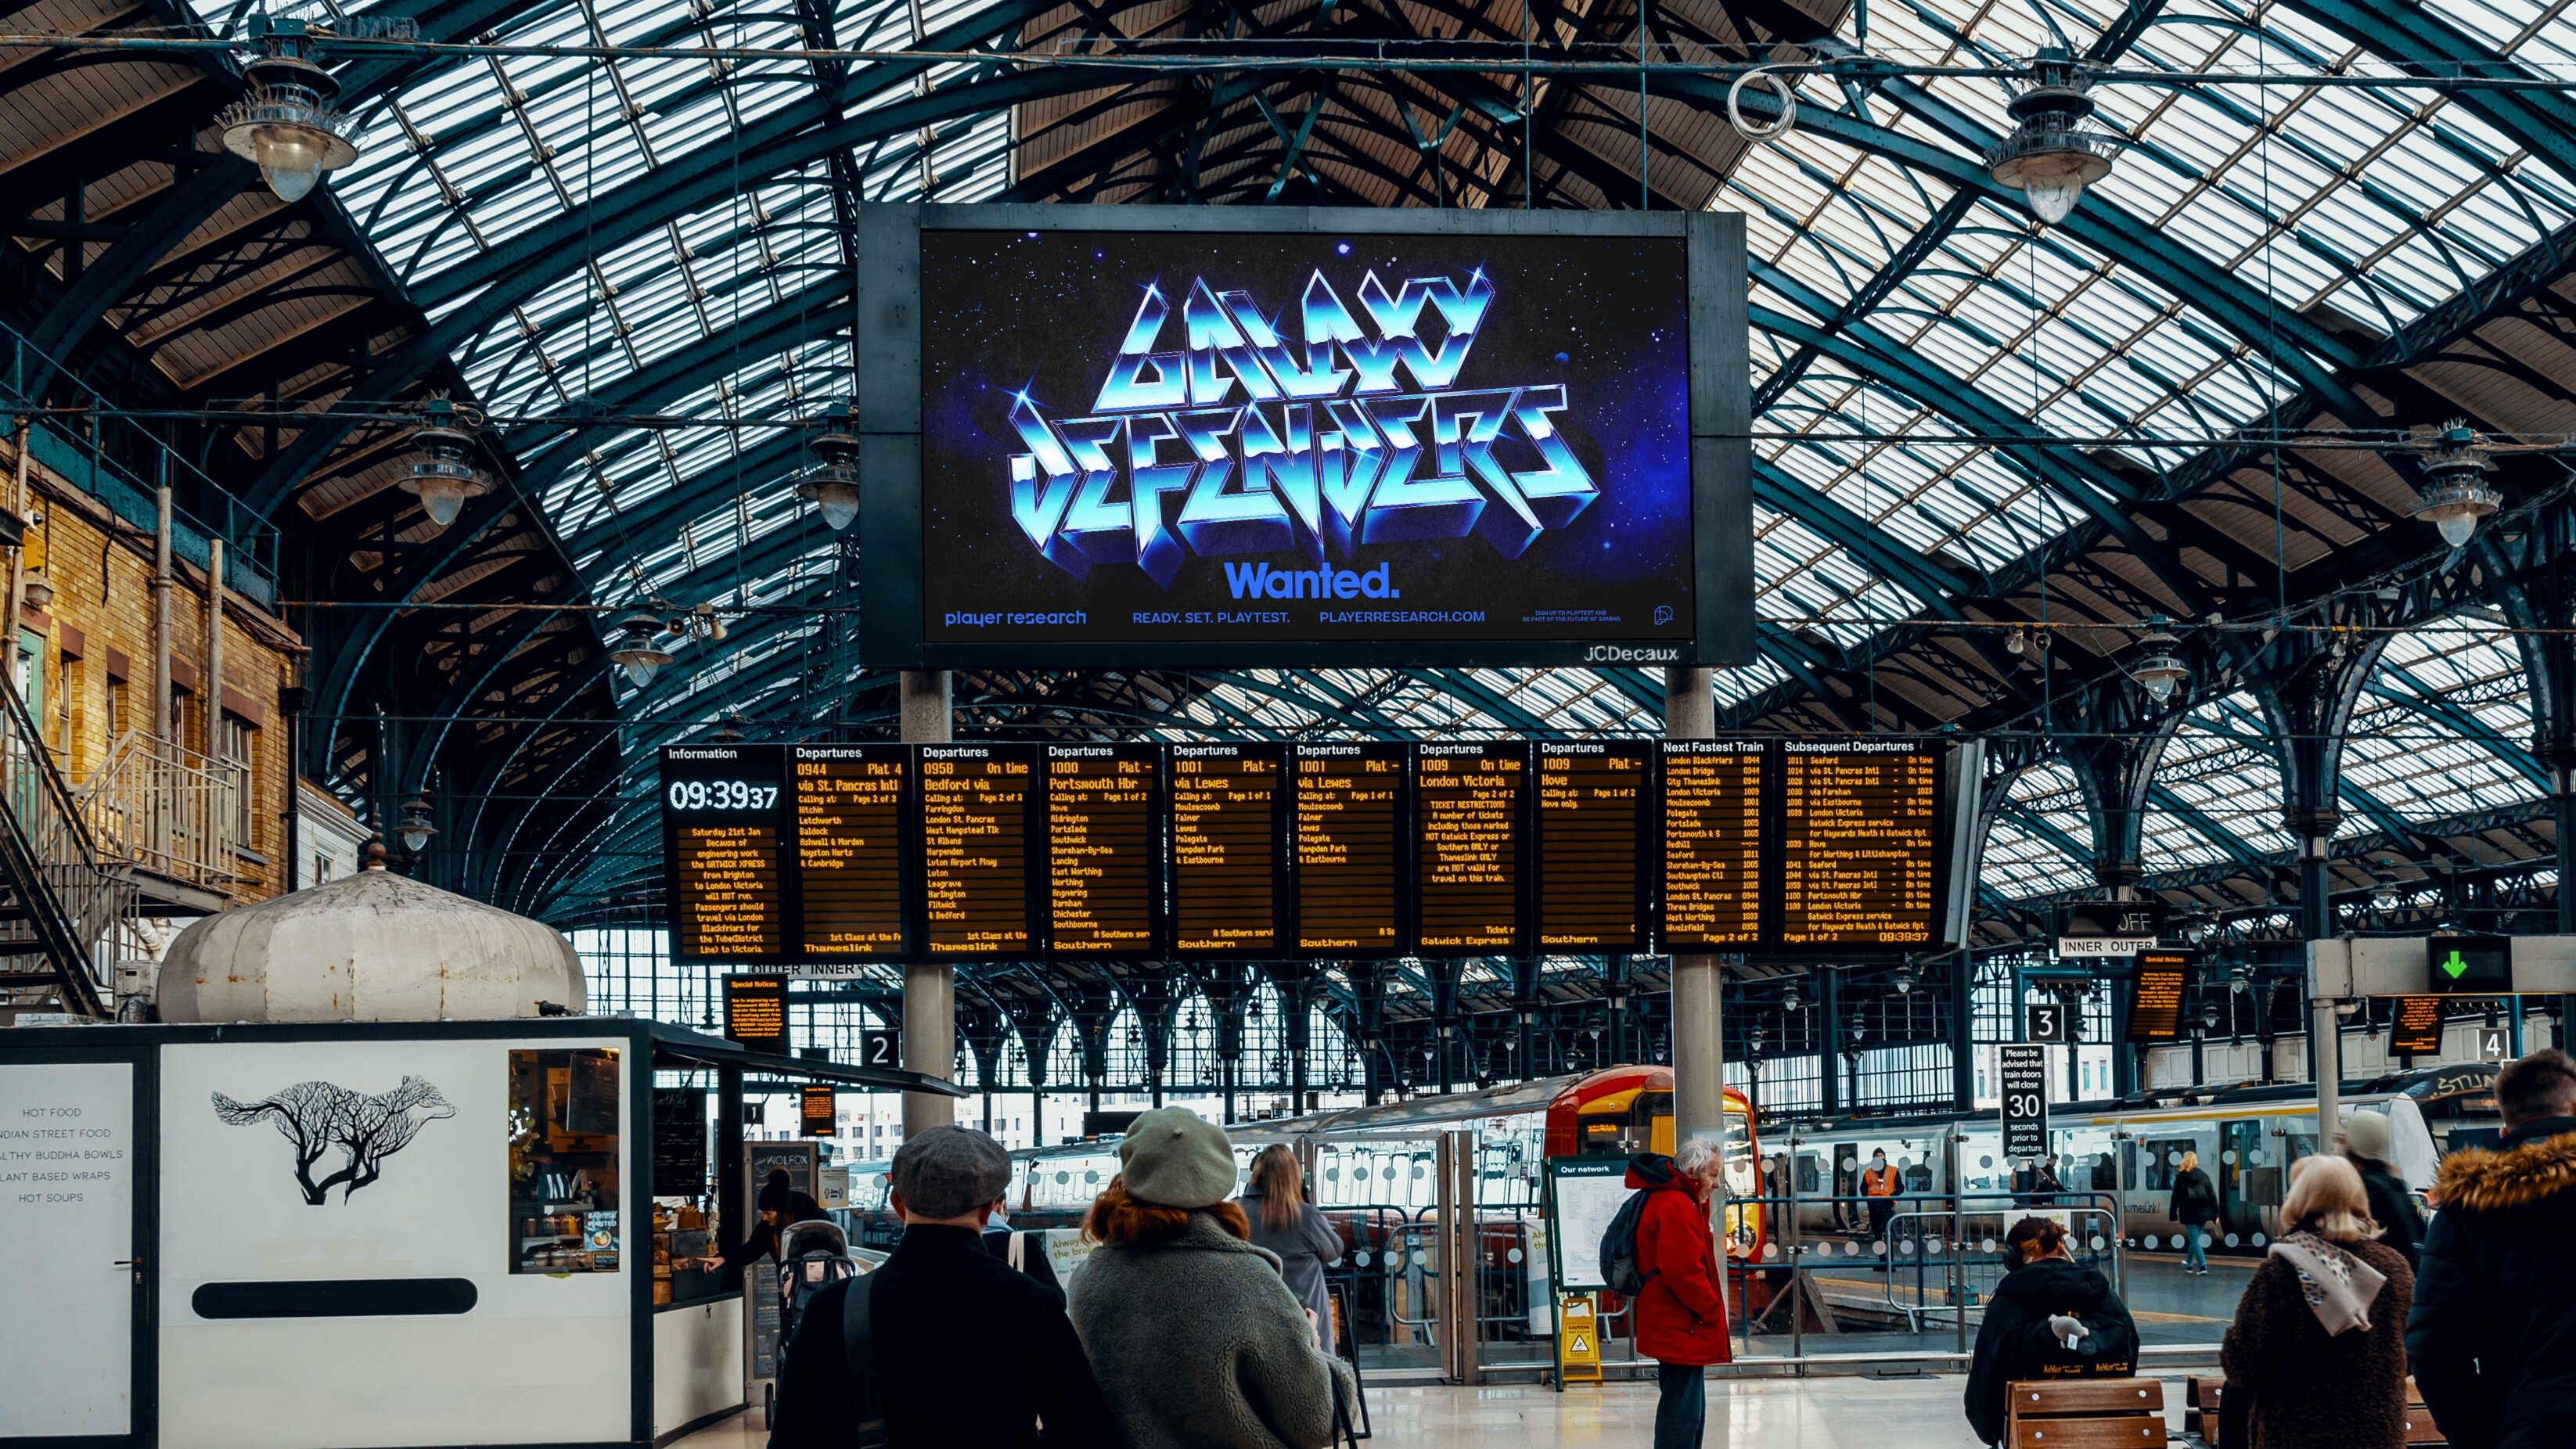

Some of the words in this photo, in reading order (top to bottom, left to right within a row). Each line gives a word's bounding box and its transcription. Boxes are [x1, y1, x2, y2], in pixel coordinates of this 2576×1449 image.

[1092, 268, 1496, 413] GALAXY
[1007, 383, 1600, 563] DEFENDERS
[1224, 562, 1400, 599] Wanted.
[946, 611, 1002, 627] player
[1007, 610, 1087, 624] research
[1132, 612, 1182, 624] READY.
[1185, 612, 1214, 624] SET.
[1217, 612, 1290, 623] PLAYTEST.
[1319, 611, 1484, 623] PLAYERRESEARCH.COM
[1585, 645, 1678, 661] JCDecaux
[1049, 746, 1114, 759] Departures
[1173, 745, 1238, 757] Departures
[1297, 745, 1361, 757] Departures
[1420, 744, 1484, 757] Departures
[1542, 742, 1605, 756] Departures
[1663, 742, 1689, 753] Next
[1692, 742, 1733, 752] Fastest
[1736, 741, 1764, 752] Train
[1784, 741, 1851, 754] Subsequent
[1853, 741, 1915, 753] Departures
[668, 748, 737, 759] Information
[796, 747, 862, 760] Departures
[923, 747, 989, 760] Departures
[1421, 759, 1448, 771] 1009
[1480, 759, 1495, 771] On
[1498, 759, 1520, 771] time
[1543, 758, 1570, 770] 1009
[1609, 757, 1630, 770] Plat
[1810, 756, 1838, 764] Seaford
[797, 763, 827, 775] 0944
[868, 763, 890, 775] Plat
[894, 763, 902, 775] 4
[924, 762, 954, 775] 0958
[987, 762, 1002, 774] On
[1006, 762, 1028, 774] time
[1051, 761, 1078, 774] 1000
[1118, 761, 1141, 773] Plat
[1175, 760, 1202, 773] 1001
[1243, 760, 1265, 772] Plat
[1299, 760, 1325, 773] 1001
[1365, 760, 1387, 772] Plat
[1667, 767, 1691, 775] London
[1693, 767, 1714, 777] Bridge
[1743, 766, 1760, 775] 0944
[797, 779, 814, 792] via
[817, 779, 833, 792] St.
[836, 779, 877, 792] Pancras
[880, 779, 898, 791] Intl
[924, 778, 970, 791] Bedford
[973, 778, 991, 790] via
[1049, 778, 1114, 790] Portsmouth
[1118, 777, 1139, 789] Hbr
[1175, 777, 1191, 789] via
[1195, 777, 1229, 789] Lewes
[1297, 776, 1314, 789] via
[1318, 776, 1352, 789] Lewes
[1419, 775, 1459, 787] London
[1462, 775, 1506, 787] Victoria
[1542, 774, 1568, 786] Hove
[925, 804, 965, 814] Farringdon
[799, 816, 842, 825] Letchworth
[1050, 814, 1088, 825] Aldrington
[692, 828, 726, 838] Saturday
[728, 828, 746, 836] 21st
[747, 827, 761, 836] Jan
[799, 827, 829, 836] Baldock
[1050, 825, 1087, 833] Portslade
[1175, 834, 1208, 844] Polegate
[926, 847, 964, 858] Harpenden
[703, 871, 721, 879] from
[723, 870, 755, 881] Brighton
[1300, 938, 1358, 947] Southern
[1421, 937, 1462, 945] Gatwick
[1466, 937, 1509, 946] Express
[1542, 935, 1598, 944] Southern
[1703, 933, 1725, 944] Page
[1728, 933, 1735, 941] 2
[1737, 933, 1749, 941] of
[1751, 933, 1758, 941] 2
[1879, 932, 1929, 942] 09:39:37
[804, 944, 872, 952] Thameslink
[930, 942, 998, 951] Thameslink
[1053, 940, 1112, 950] Southern
[1178, 940, 1236, 948] Southern
[2064, 941, 2103, 952] INNER
[2110, 940, 2153, 952] OUTER
[810, 964, 854, 976] INNER
[2038, 1011, 2053, 1034] 3
[872, 1037, 889, 1064] 2
[2486, 1034, 2501, 1056] 4
[2006, 1049, 2028, 1058] Please
[2028, 1048, 2038, 1057] be
[2002, 1059, 2028, 1068] advised
[2028, 1059, 2043, 1068] that
[2004, 1070, 2021, 1079] train
[2006, 1080, 2020, 1089] will
[2020, 1080, 2039, 1089] close
[2009, 1095, 2039, 1116] 30
[23, 1109, 46, 1117] HOT
[50, 1108, 81, 1117] FOOD
[752, 1106, 756, 1120] 1
[2009, 1123, 2038, 1131] seconds
[33, 1129, 75, 1138] STREET
[80, 1129, 111, 1138] FOOD
[2012, 1134, 2030, 1144] prior
[0, 1152, 31, 1160] LTHY
[36, 1151, 80, 1160] BUDDHA
[85, 1150, 123, 1159] BOWLS
[2008, 1144, 2042, 1154] departure
[767, 1156, 808, 1165] WOLFOX
[32, 1172, 68, 1181] BASED
[19, 1194, 42, 1203] HOT
[46, 1193, 84, 1202] SOUPS
